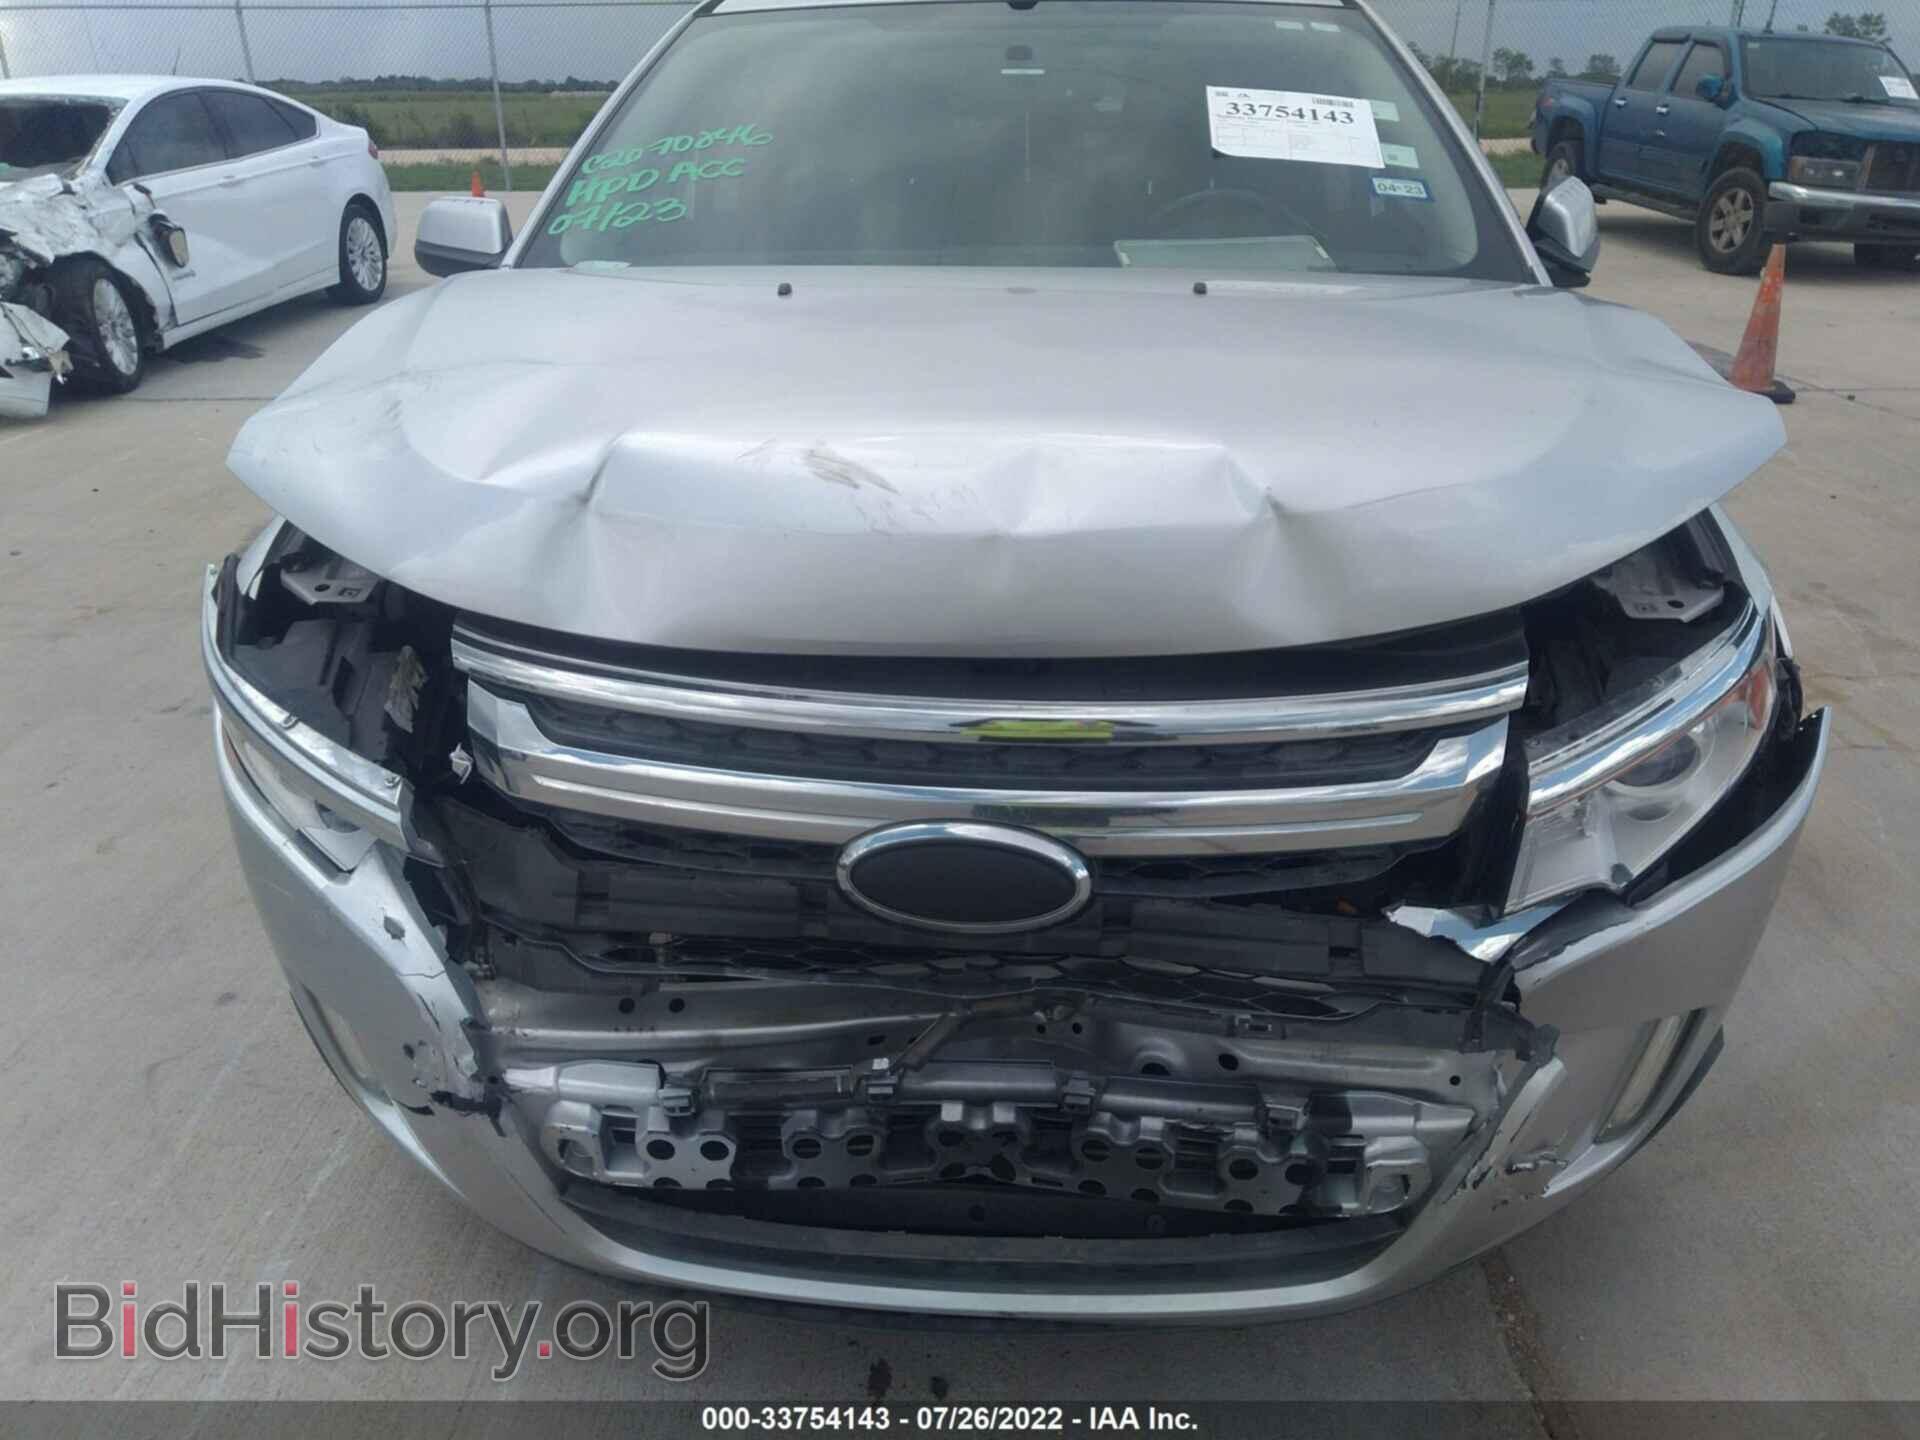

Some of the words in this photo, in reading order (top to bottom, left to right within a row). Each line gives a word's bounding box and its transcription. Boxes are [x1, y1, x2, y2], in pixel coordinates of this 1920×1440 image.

[1225, 102, 1354, 125] 33754143
[566, 168, 659, 207] HPD
[667, 158, 745, 183] ACC
